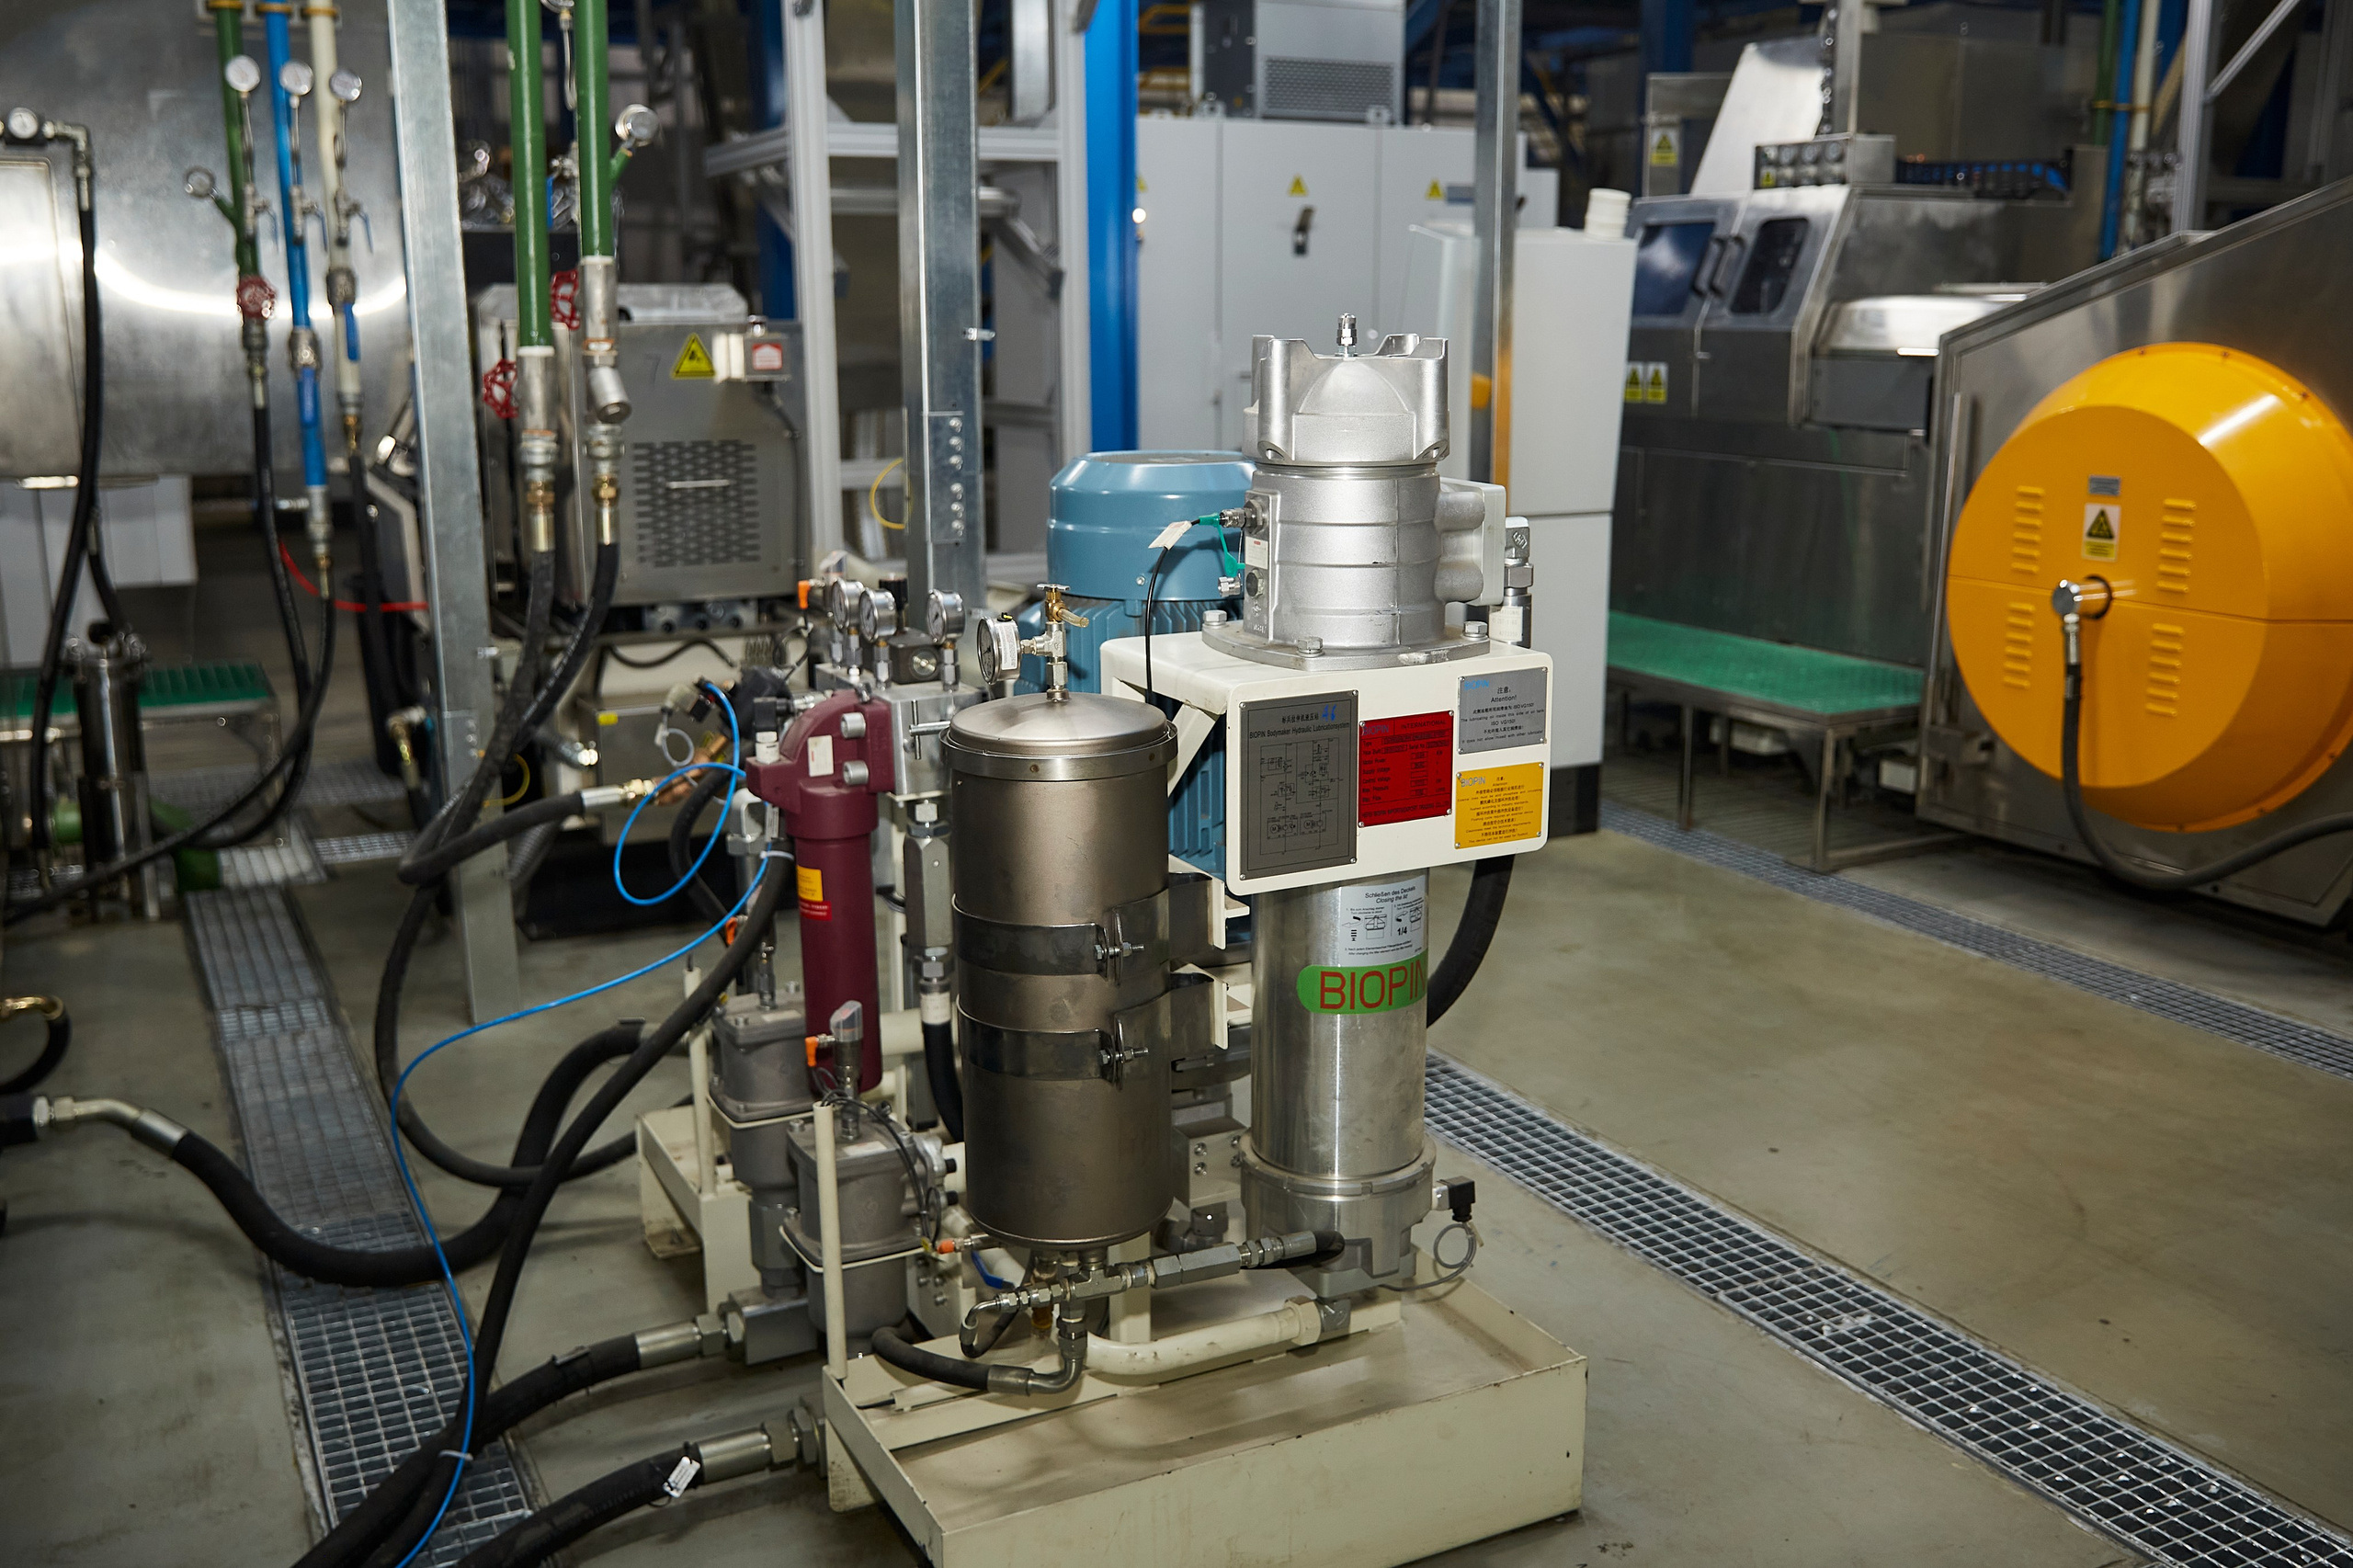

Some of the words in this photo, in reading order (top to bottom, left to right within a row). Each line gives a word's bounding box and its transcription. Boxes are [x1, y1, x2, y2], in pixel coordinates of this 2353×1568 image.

[1461, 777, 1486, 787] BIOPIN
[1397, 926, 1408, 935] 1/4
[1320, 960, 1425, 1009] BIOPIN
